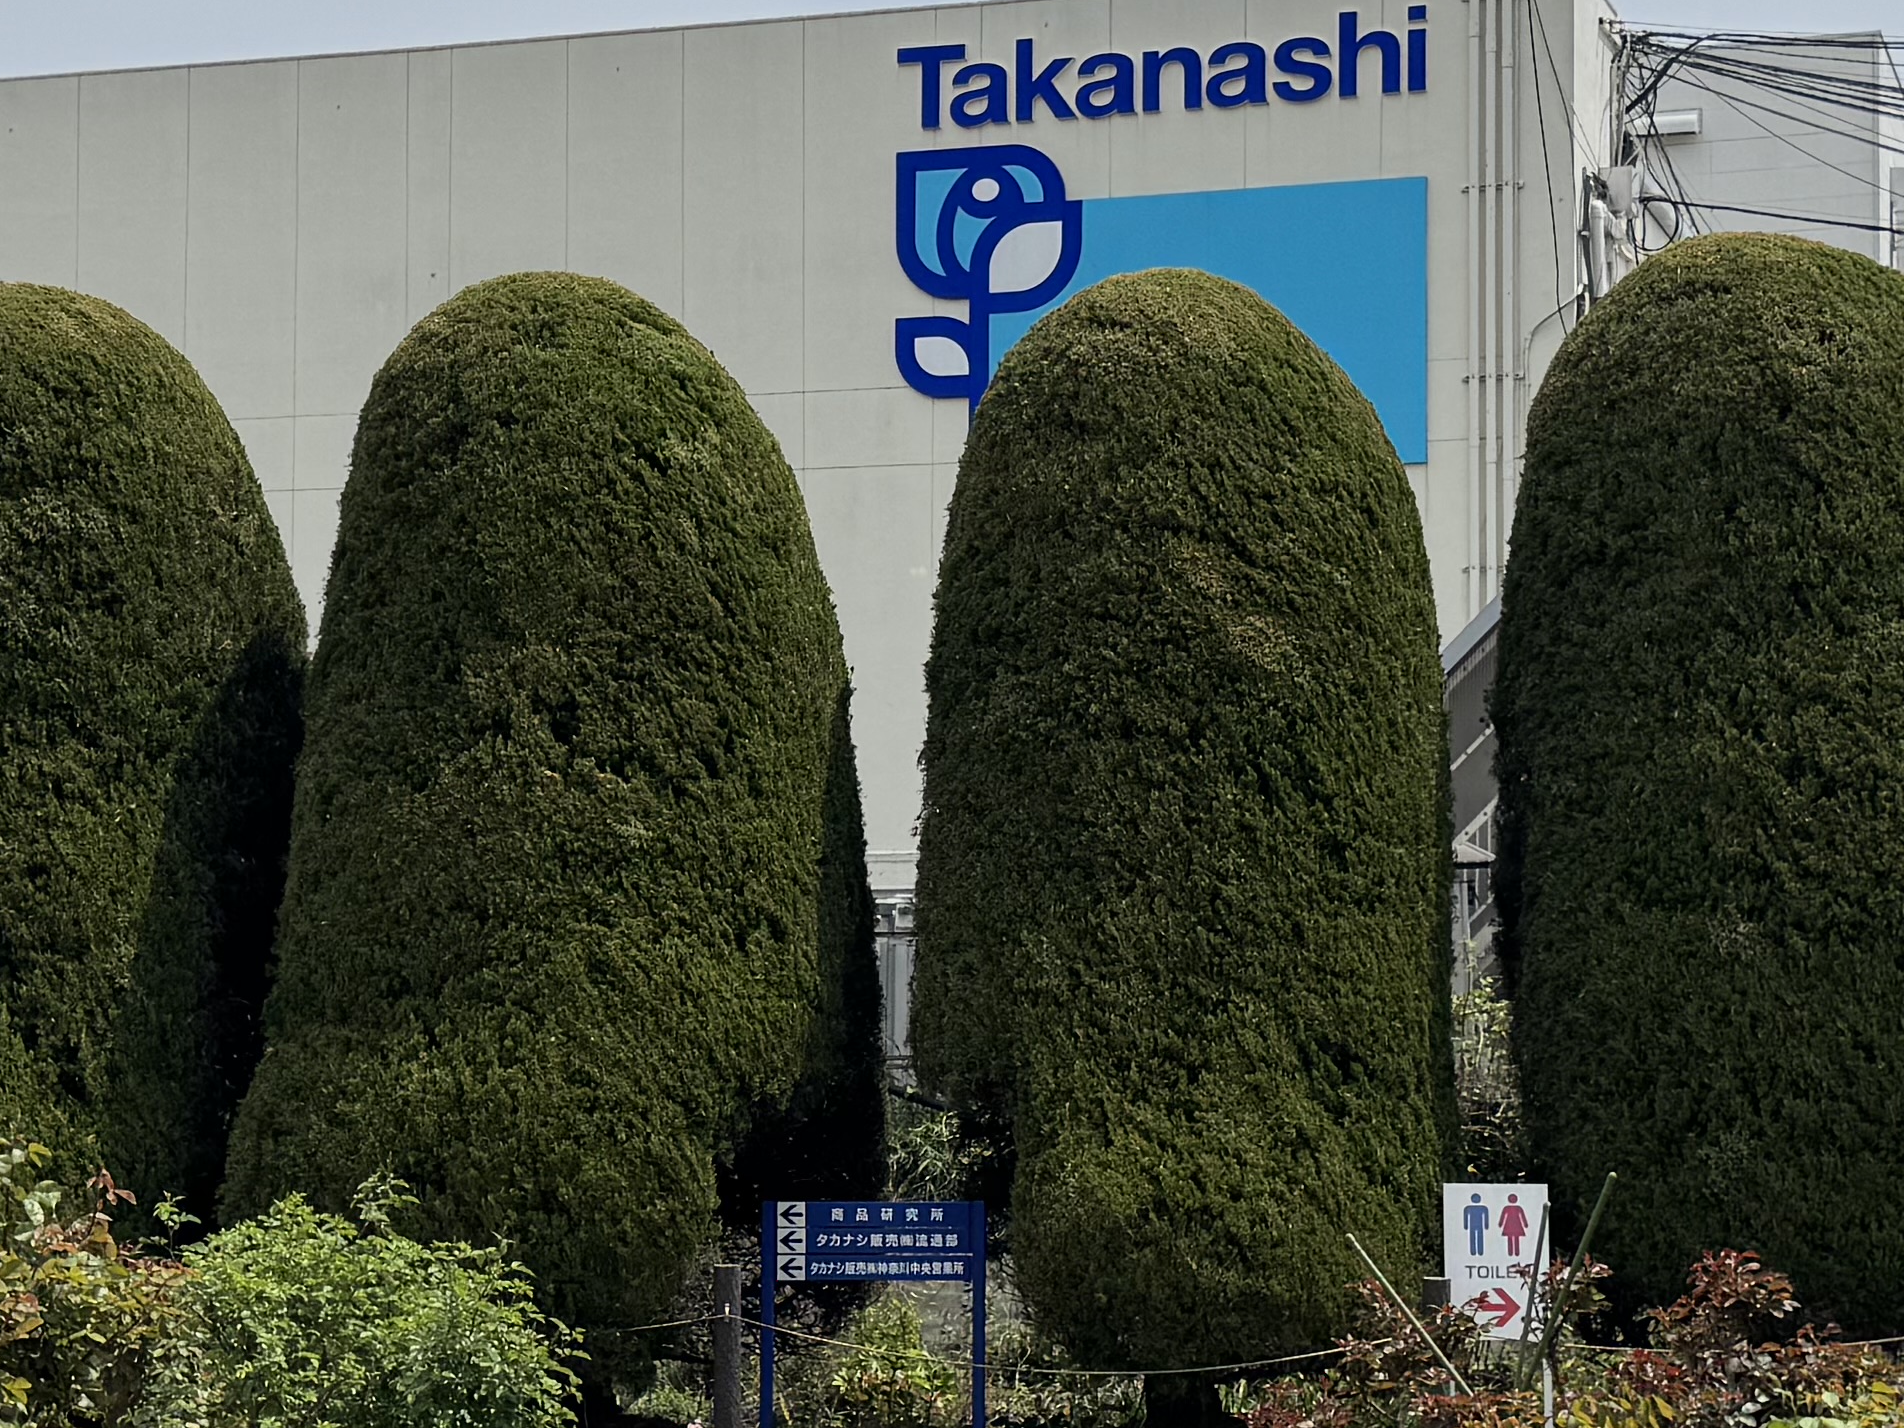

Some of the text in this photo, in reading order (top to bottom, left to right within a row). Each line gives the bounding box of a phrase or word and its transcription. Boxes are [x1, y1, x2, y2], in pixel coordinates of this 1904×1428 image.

[897, 4, 1428, 131] Takanashi
[831, 1207, 944, 1222] 商品研究所
[1464, 1265, 1530, 1279] TOILE
